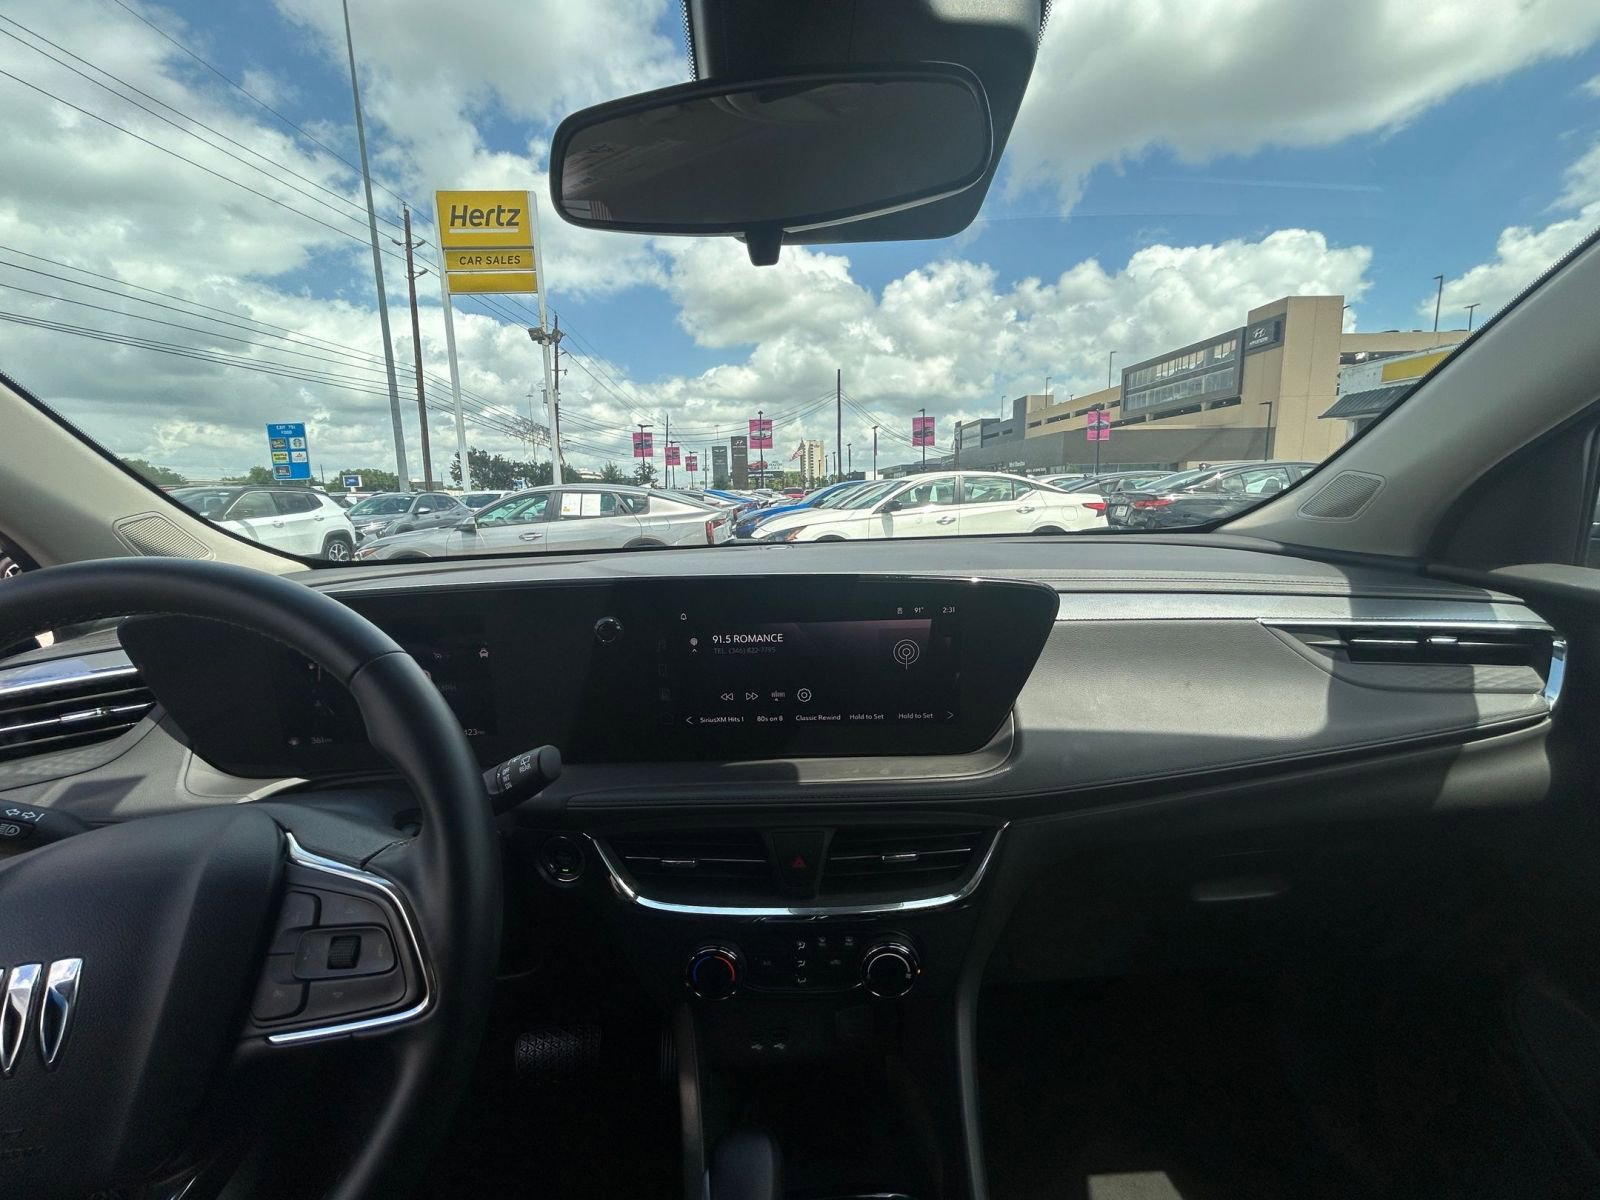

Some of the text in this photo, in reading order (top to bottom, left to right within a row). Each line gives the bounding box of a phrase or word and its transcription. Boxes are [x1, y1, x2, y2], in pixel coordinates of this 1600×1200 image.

[449, 205, 521, 227] Hertz
[459, 255, 521, 265] CAR SALES
[942, 606, 956, 614] 2:31
[712, 633, 784, 644] 91.5 ROMANCE
[699, 715, 727, 724] SiriusXM
[728, 715, 740, 723] Hits
[756, 715, 769, 723] 80s
[795, 713, 841, 722] Classic Rewind
[849, 713, 865, 721] Hold
[898, 712, 914, 720] Hold
[519, 763, 531, 773] REAR
